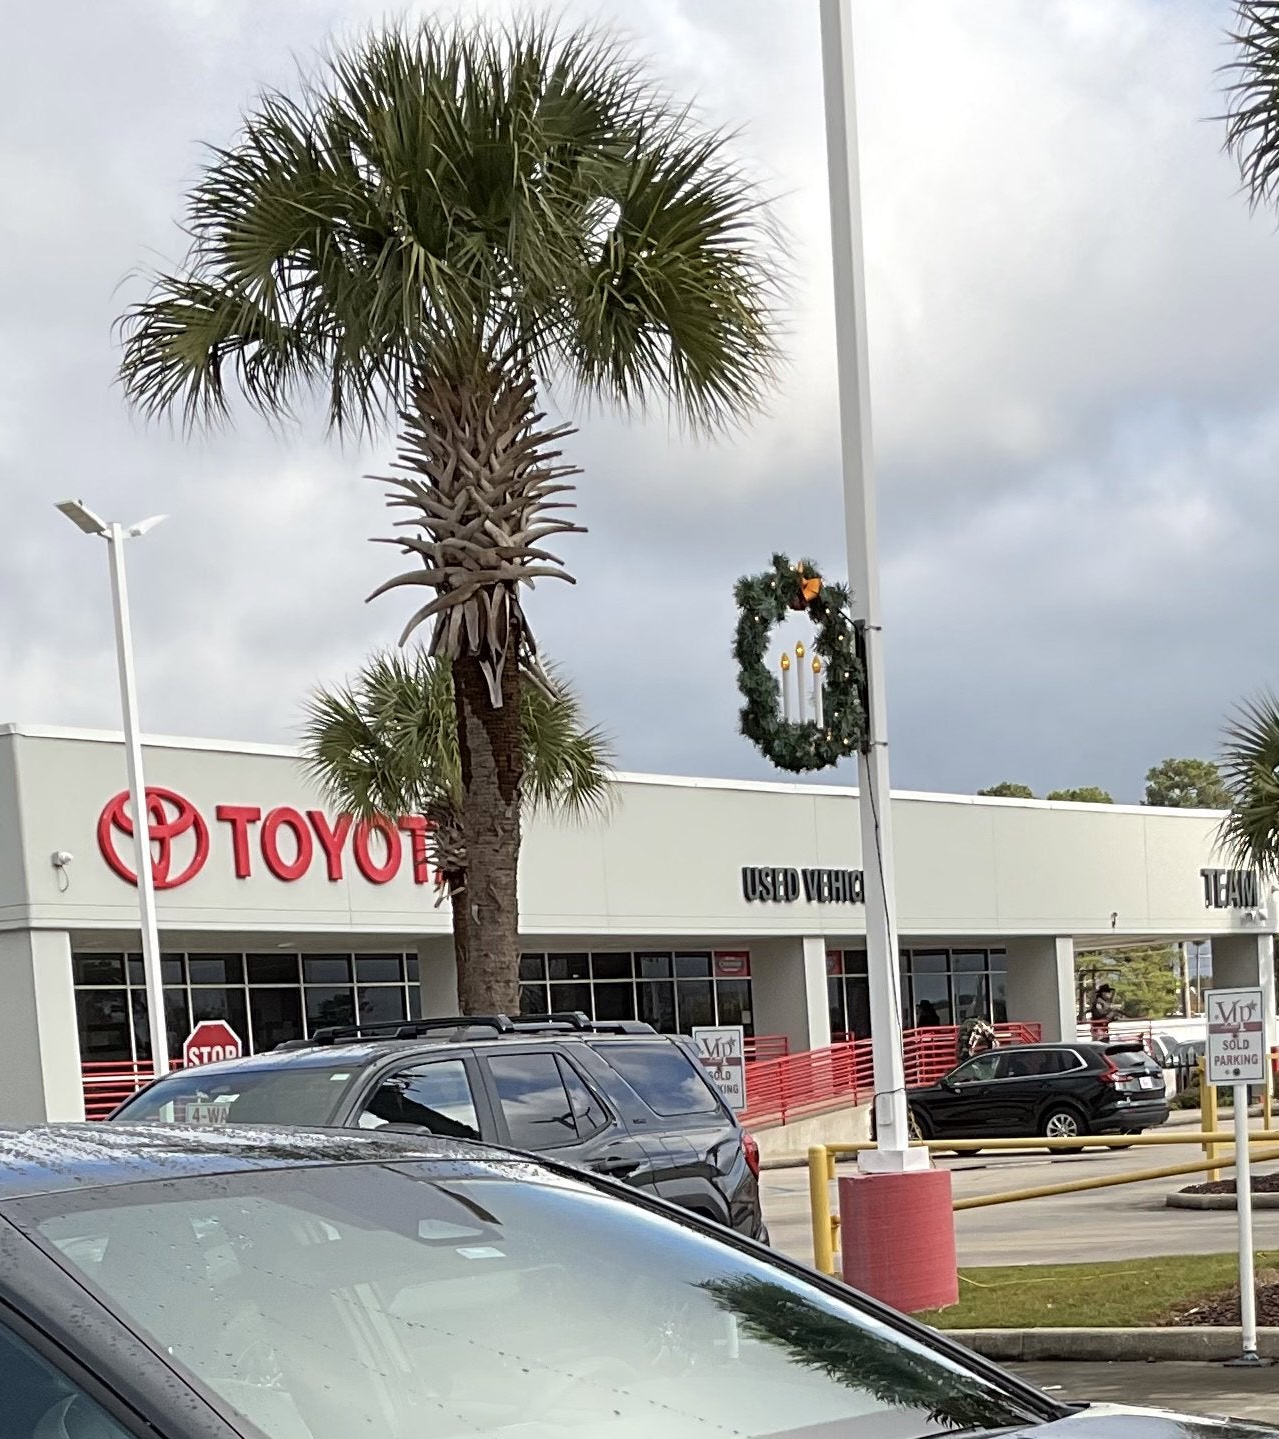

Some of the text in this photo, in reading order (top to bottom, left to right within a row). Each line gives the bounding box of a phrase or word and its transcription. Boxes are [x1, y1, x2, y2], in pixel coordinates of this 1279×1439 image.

[216, 805, 446, 885] TOYOT
[742, 867, 866, 904] USED VEHIC
[1200, 868, 1258, 909] TEAM
[188, 1045, 237, 1067] STOP
[1222, 1039, 1250, 1051] SOLD
[1214, 1054, 1259, 1067] PARKING
[191, 1107, 229, 1123] 4-WA
